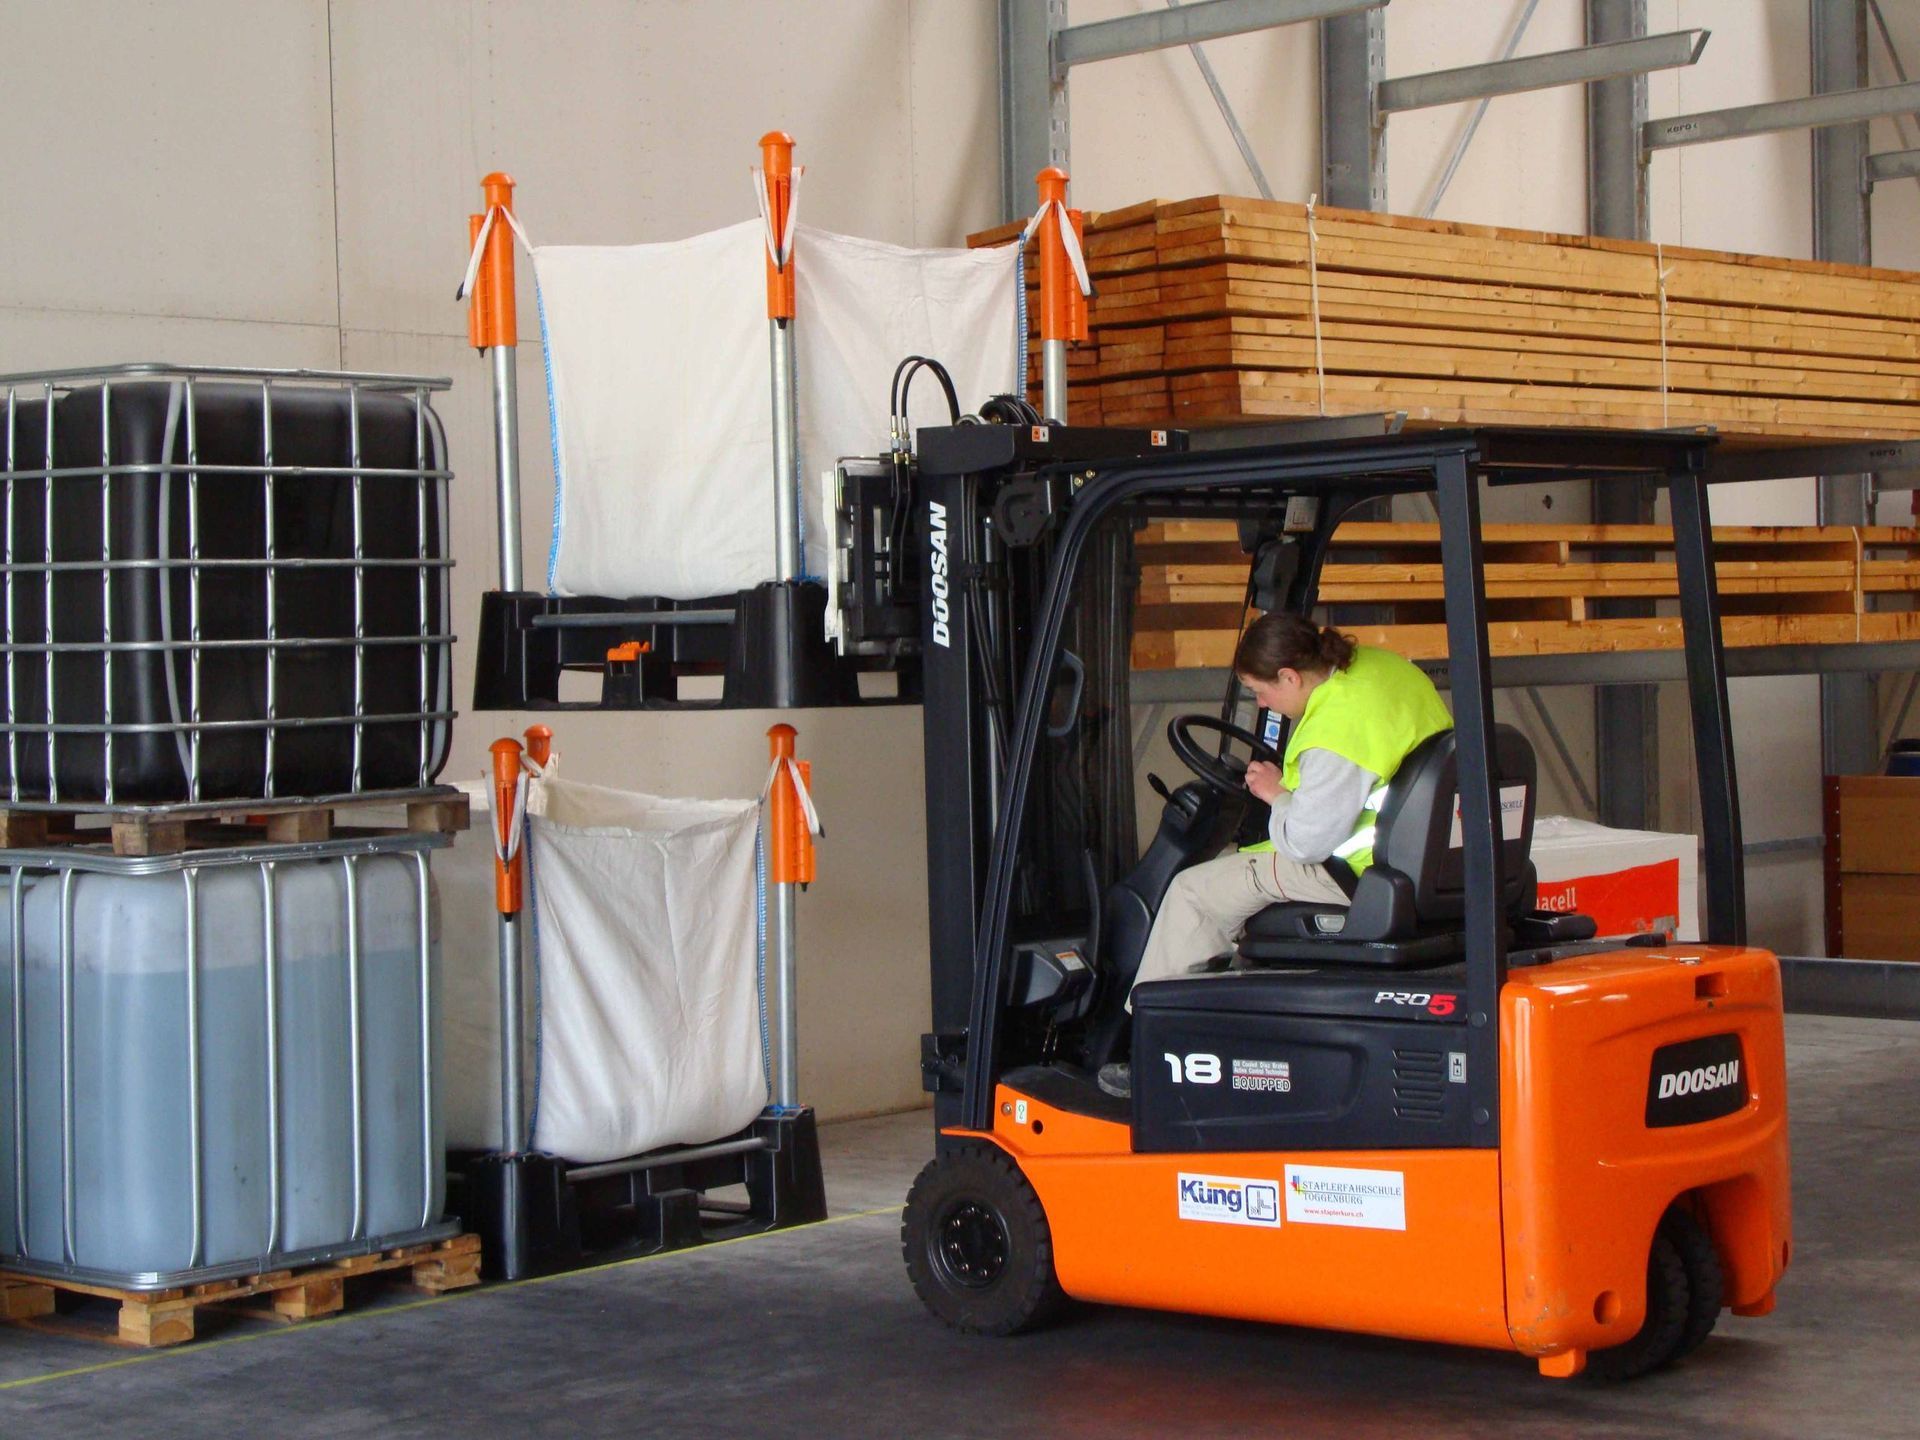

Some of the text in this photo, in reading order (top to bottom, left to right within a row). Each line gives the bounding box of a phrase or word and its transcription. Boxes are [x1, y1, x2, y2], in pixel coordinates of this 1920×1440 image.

[929, 501, 950, 648] DOOSAN
[1164, 1052, 1222, 1084] 18
[1232, 1076, 1291, 1092] EQUIPPED
[1658, 1060, 1739, 1099] DOOSAN
[1302, 1181, 1401, 1196] STAPLERFAHRSCHULE
[1303, 1193, 1363, 1205] TOGGENBURG
[1303, 1207, 1364, 1218] www.staplerkurs.ch
